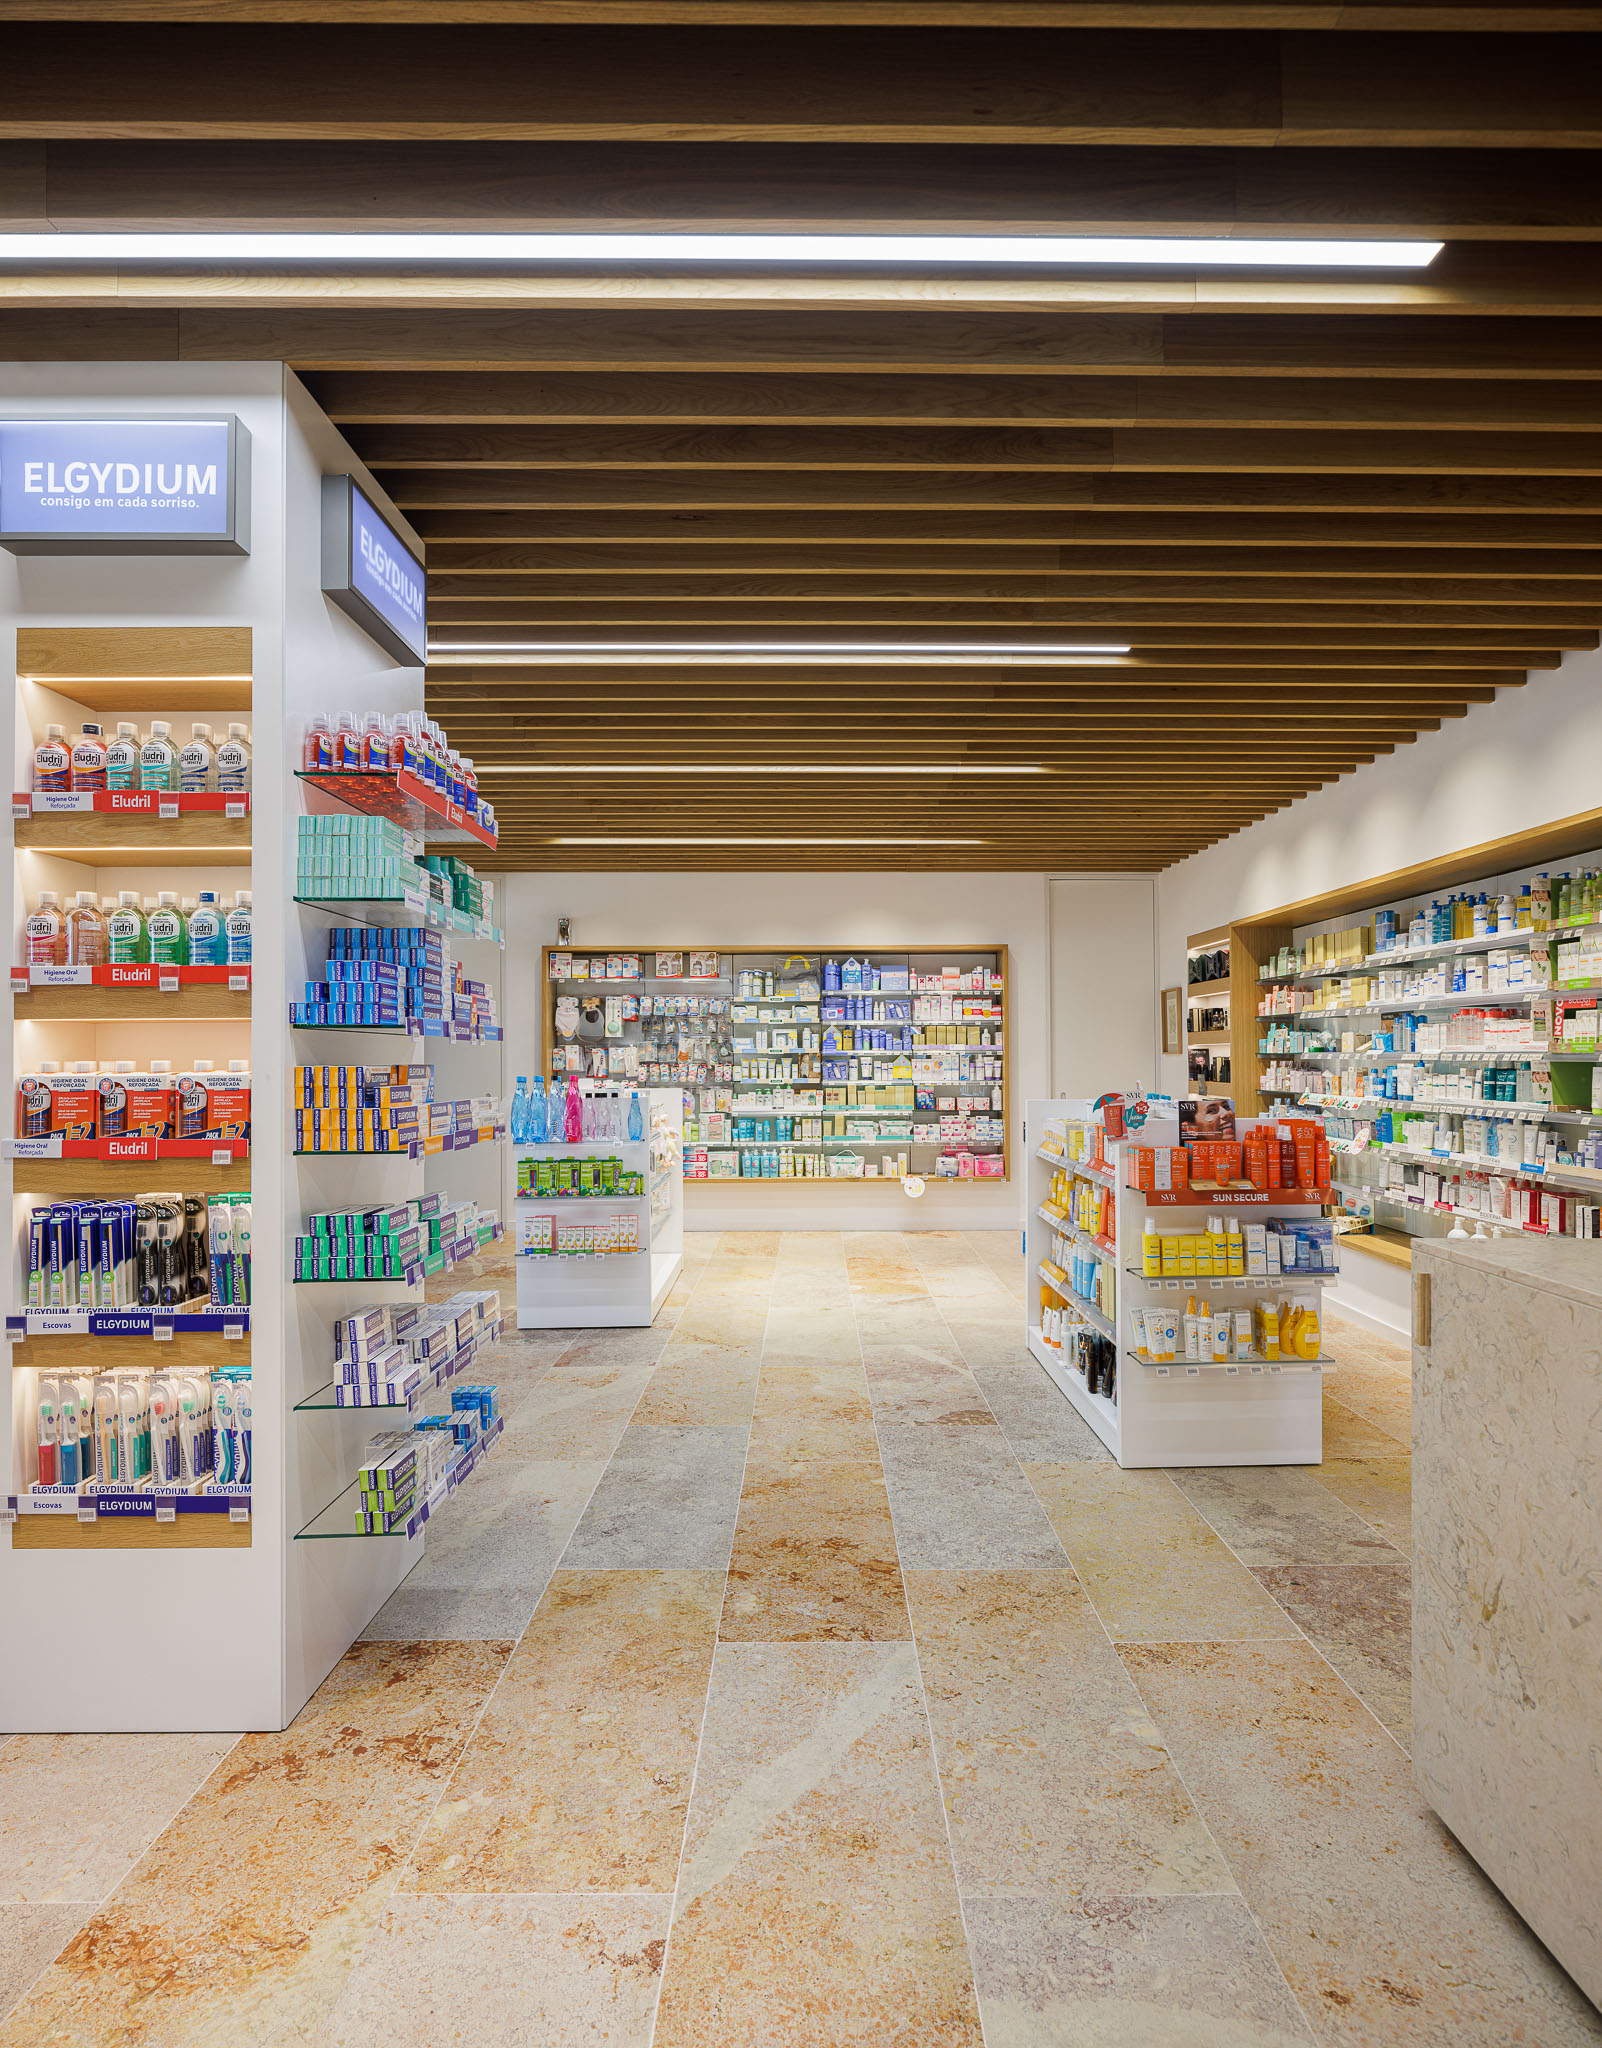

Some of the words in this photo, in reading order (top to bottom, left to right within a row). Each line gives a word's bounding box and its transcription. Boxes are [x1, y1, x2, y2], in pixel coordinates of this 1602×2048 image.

[23, 461, 217, 496] ELGYDIUM
[40, 496, 91, 510] consigo
[94, 498, 114, 508] em
[117, 496, 148, 508] cada
[151, 496, 200, 509] sorriso.
[360, 523, 423, 618] ELGYDIUM
[36, 754, 63, 765] Eludril
[73, 753, 101, 764] Eludril
[112, 794, 151, 808] Eludril
[44, 969, 65, 977] Higiene
[112, 968, 151, 981] Eludril
[1554, 999, 1564, 1036] NOVO
[1126, 1092, 1141, 1100] SVR
[1180, 1102, 1195, 1111] SVR
[108, 1141, 148, 1155] Eludril
[1160, 1193, 1176, 1201] SVR
[1212, 1194, 1232, 1202] SUN
[1233, 1193, 1269, 1202] SECURE
[1304, 1192, 1321, 1200] SVR
[42, 1321, 72, 1329] Escovas
[96, 1319, 150, 1329] ELGYDIUM
[32, 1486, 76, 1494] ELGYDIUM
[89, 1485, 134, 1494] ELGYDIUM
[145, 1487, 189, 1495] ELGYDIUM
[206, 1485, 252, 1494] ELGYDIUM
[33, 1501, 63, 1509] Escovas
[99, 1500, 152, 1511] ELGYDIUM
